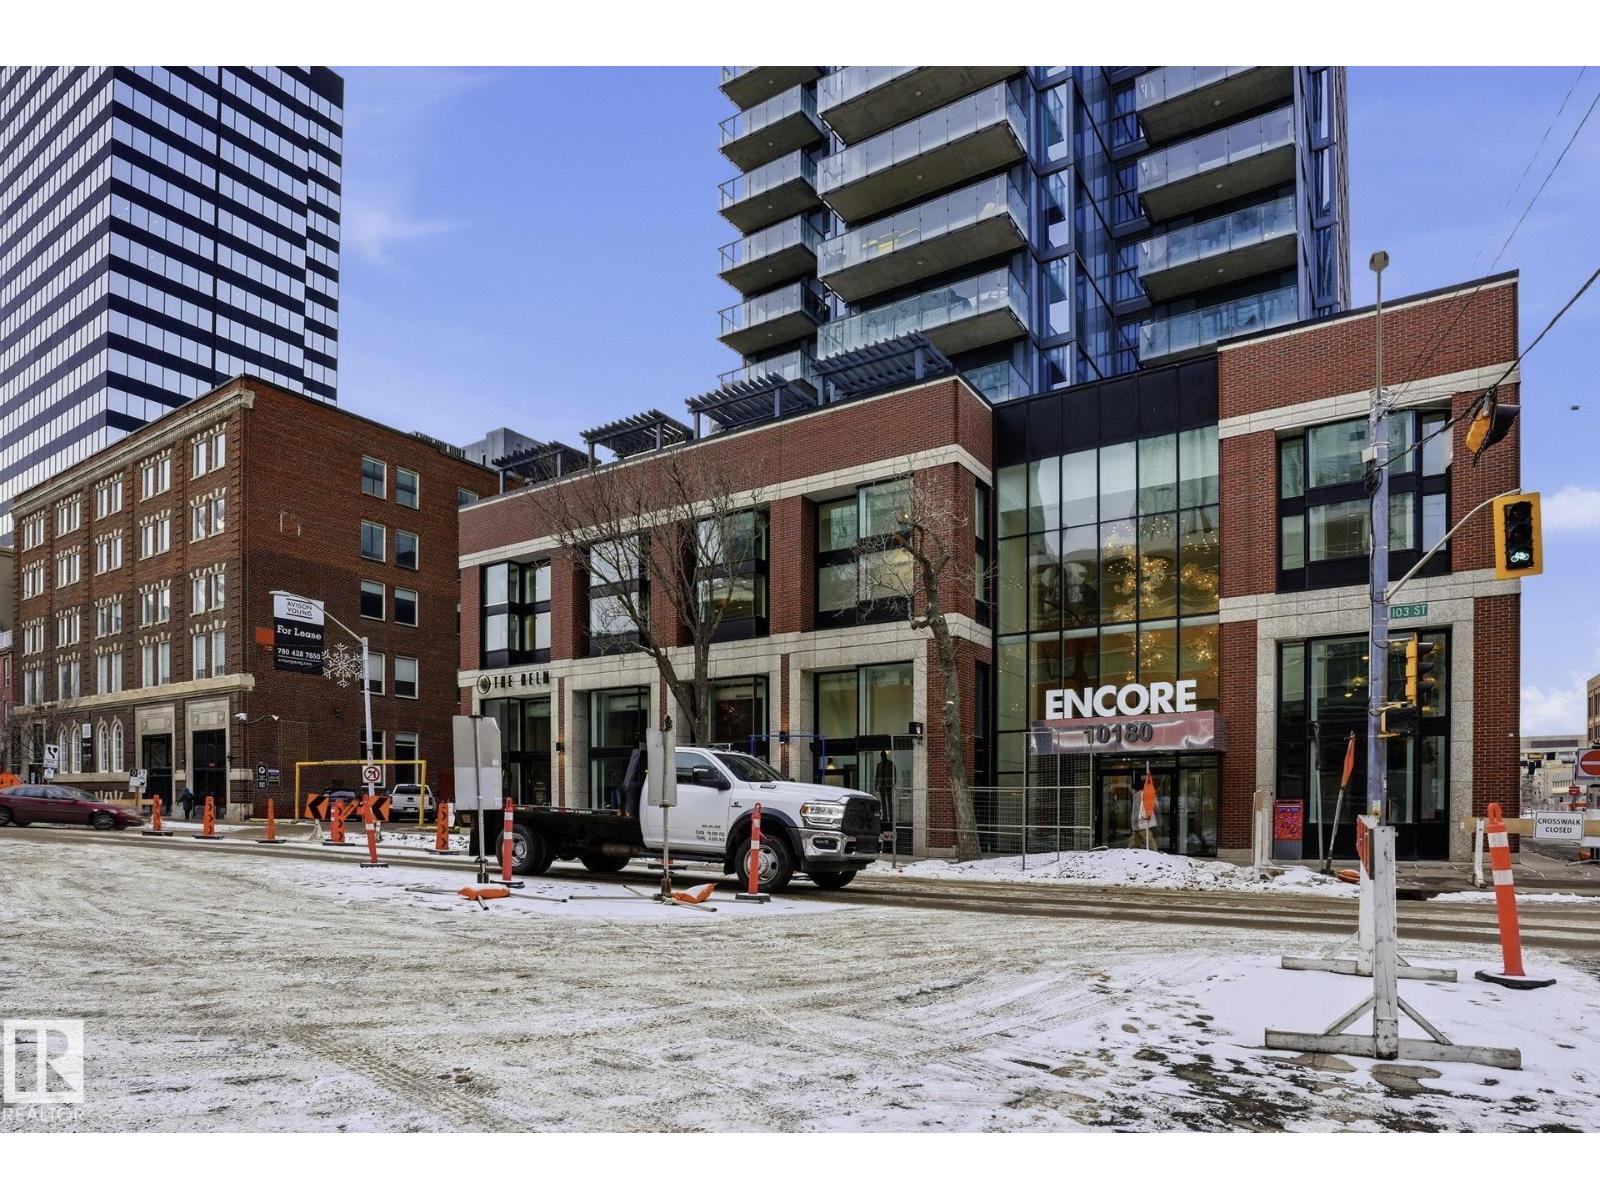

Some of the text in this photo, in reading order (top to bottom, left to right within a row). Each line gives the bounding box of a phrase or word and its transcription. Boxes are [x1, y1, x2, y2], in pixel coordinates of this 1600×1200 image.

[287, 601, 312, 611] AVISON
[287, 607, 312, 617] YOUNG
[1392, 604, 1426, 618] 103 ST
[277, 624, 322, 640] For Lease
[493, 671, 550, 689] THE HELM
[1045, 679, 1197, 720] ENCORE
[1083, 722, 1153, 745] 10180
[1537, 817, 1582, 826] CROSSWALK
[1545, 826, 1572, 835] CLOSED
